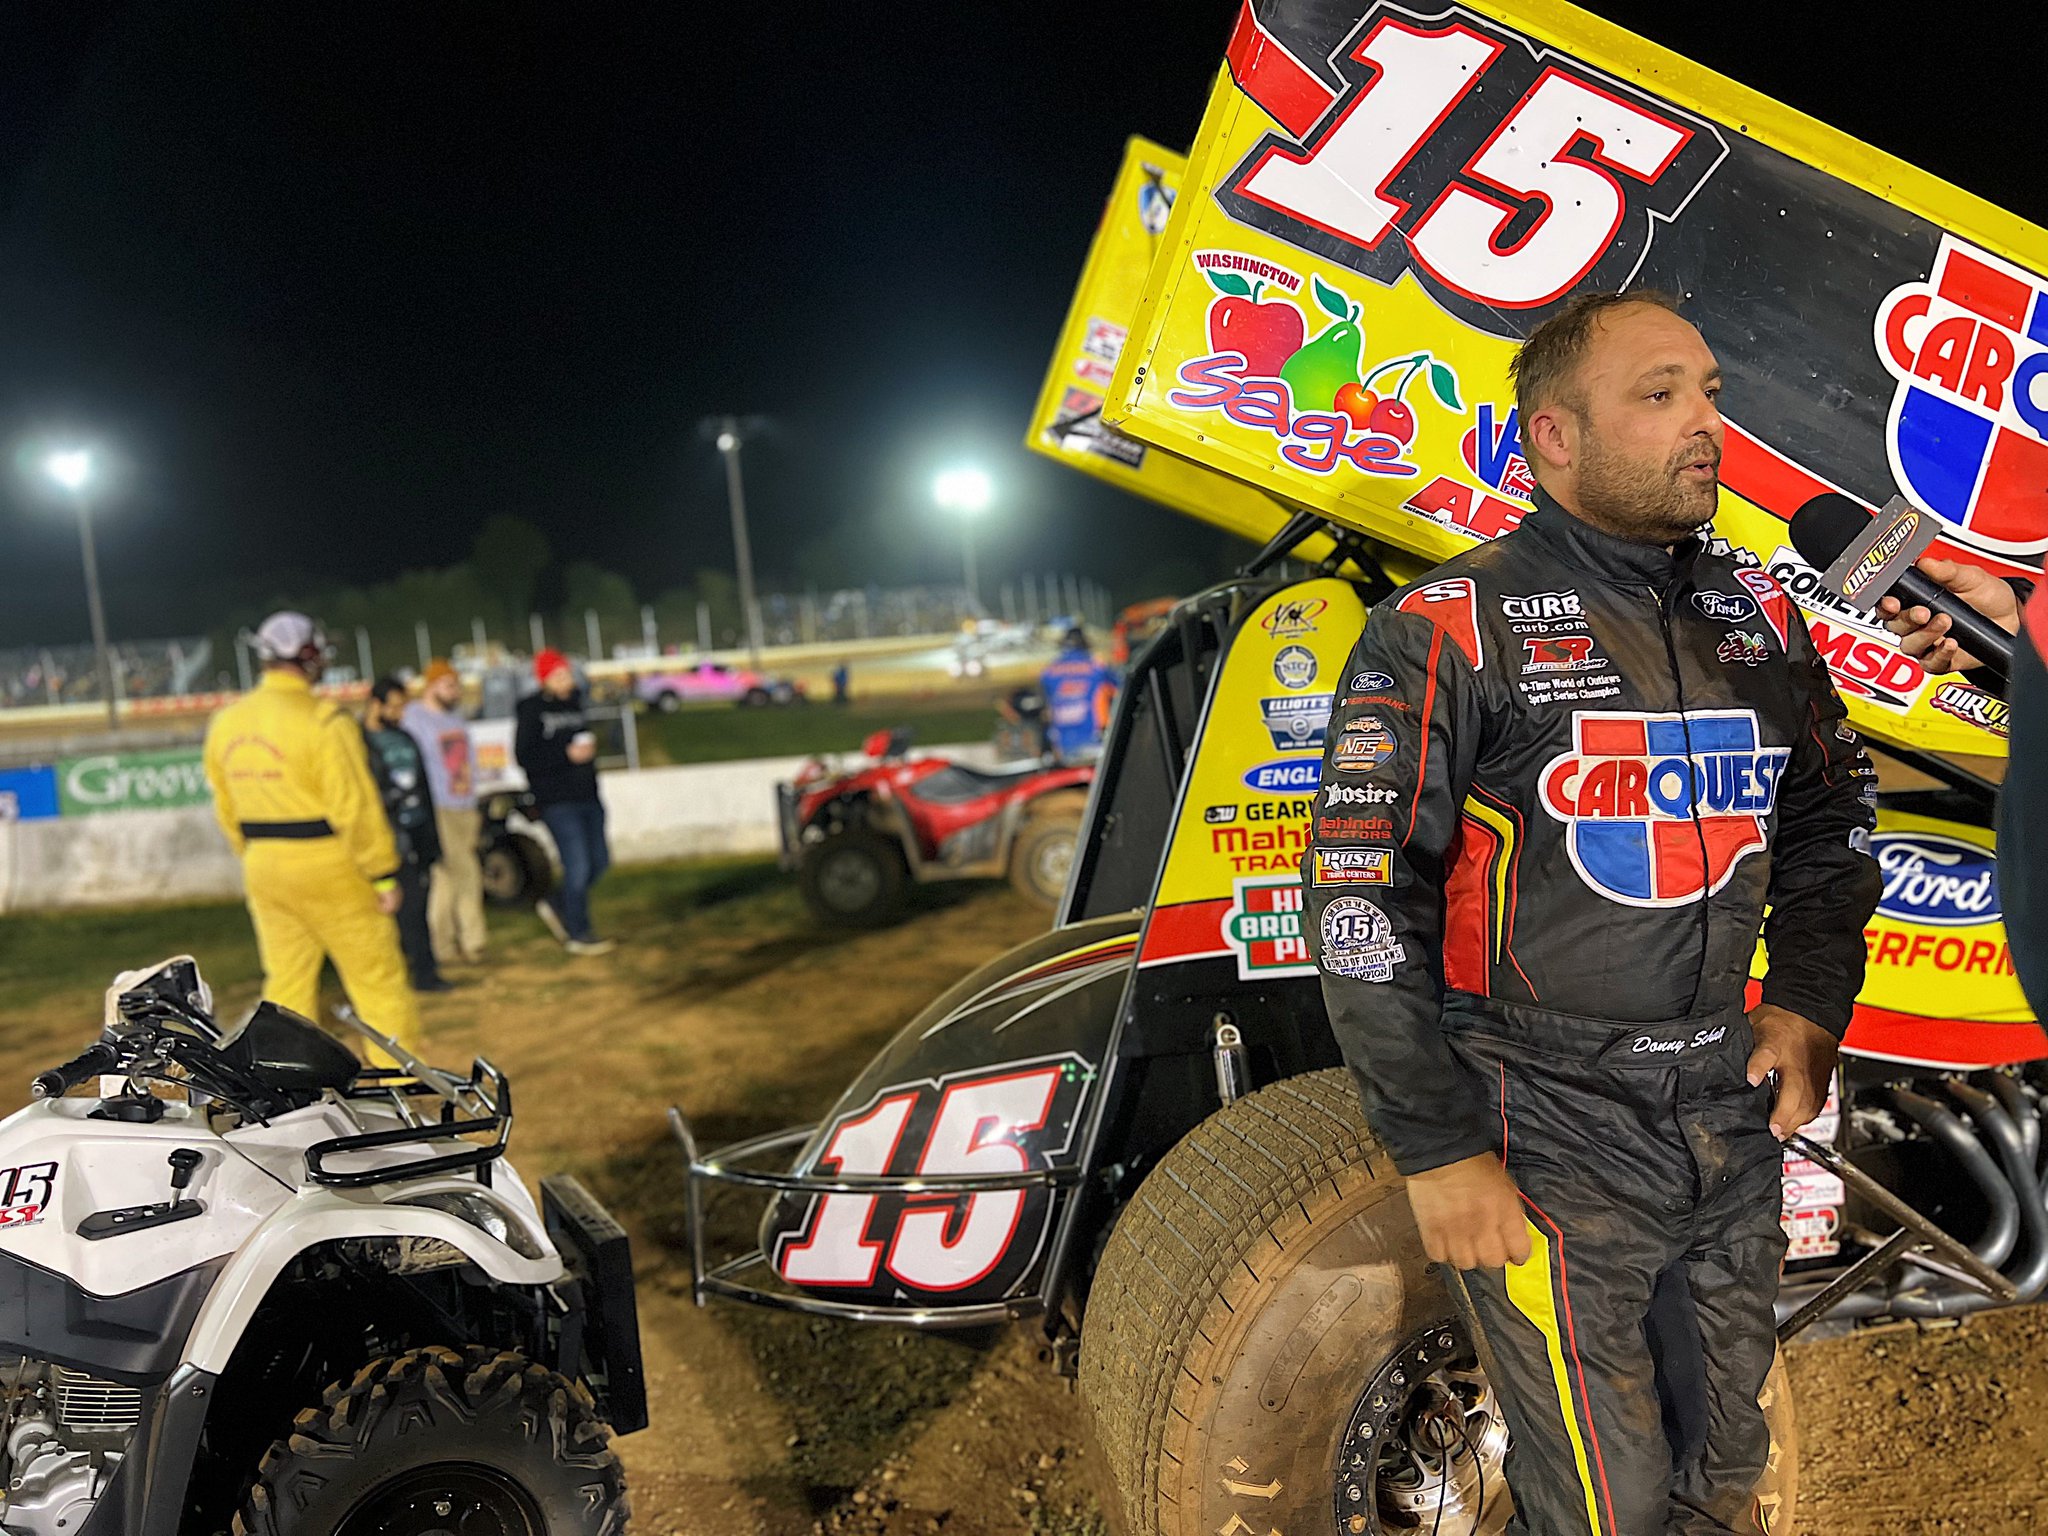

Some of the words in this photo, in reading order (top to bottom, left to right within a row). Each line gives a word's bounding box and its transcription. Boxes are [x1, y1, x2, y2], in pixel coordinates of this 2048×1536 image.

[1232, 17, 1695, 309] 15
[1196, 253, 1301, 291] WASHINGTON
[1171, 356, 1417, 476] Sage
[1402, 504, 1444, 524] automotive
[1701, 595, 1745, 615] Ford
[1512, 619, 1590, 634] curb.com
[1810, 621, 1925, 692] MSD
[1353, 674, 1385, 689] Ford
[1552, 678, 1575, 689] World
[1576, 678, 1586, 688] of
[1587, 675, 1621, 686] Outlaws
[1553, 690, 1579, 701] Series
[1579, 686, 1621, 699] Champion
[1341, 735, 1386, 755] NOS
[1258, 766, 1322, 787] ENGL
[1546, 754, 1789, 819] CARQUEST
[1322, 850, 1385, 872] RUSH
[1346, 870, 1376, 879] CENTERS
[1877, 842, 1993, 913] Ford
[1335, 914, 1374, 942] 15
[1350, 957, 1360, 966] OF
[1362, 949, 1402, 965] OUTLAWS
[1632, 1036, 1686, 1055] Donny
[782, 1065, 1063, 1292] 15
